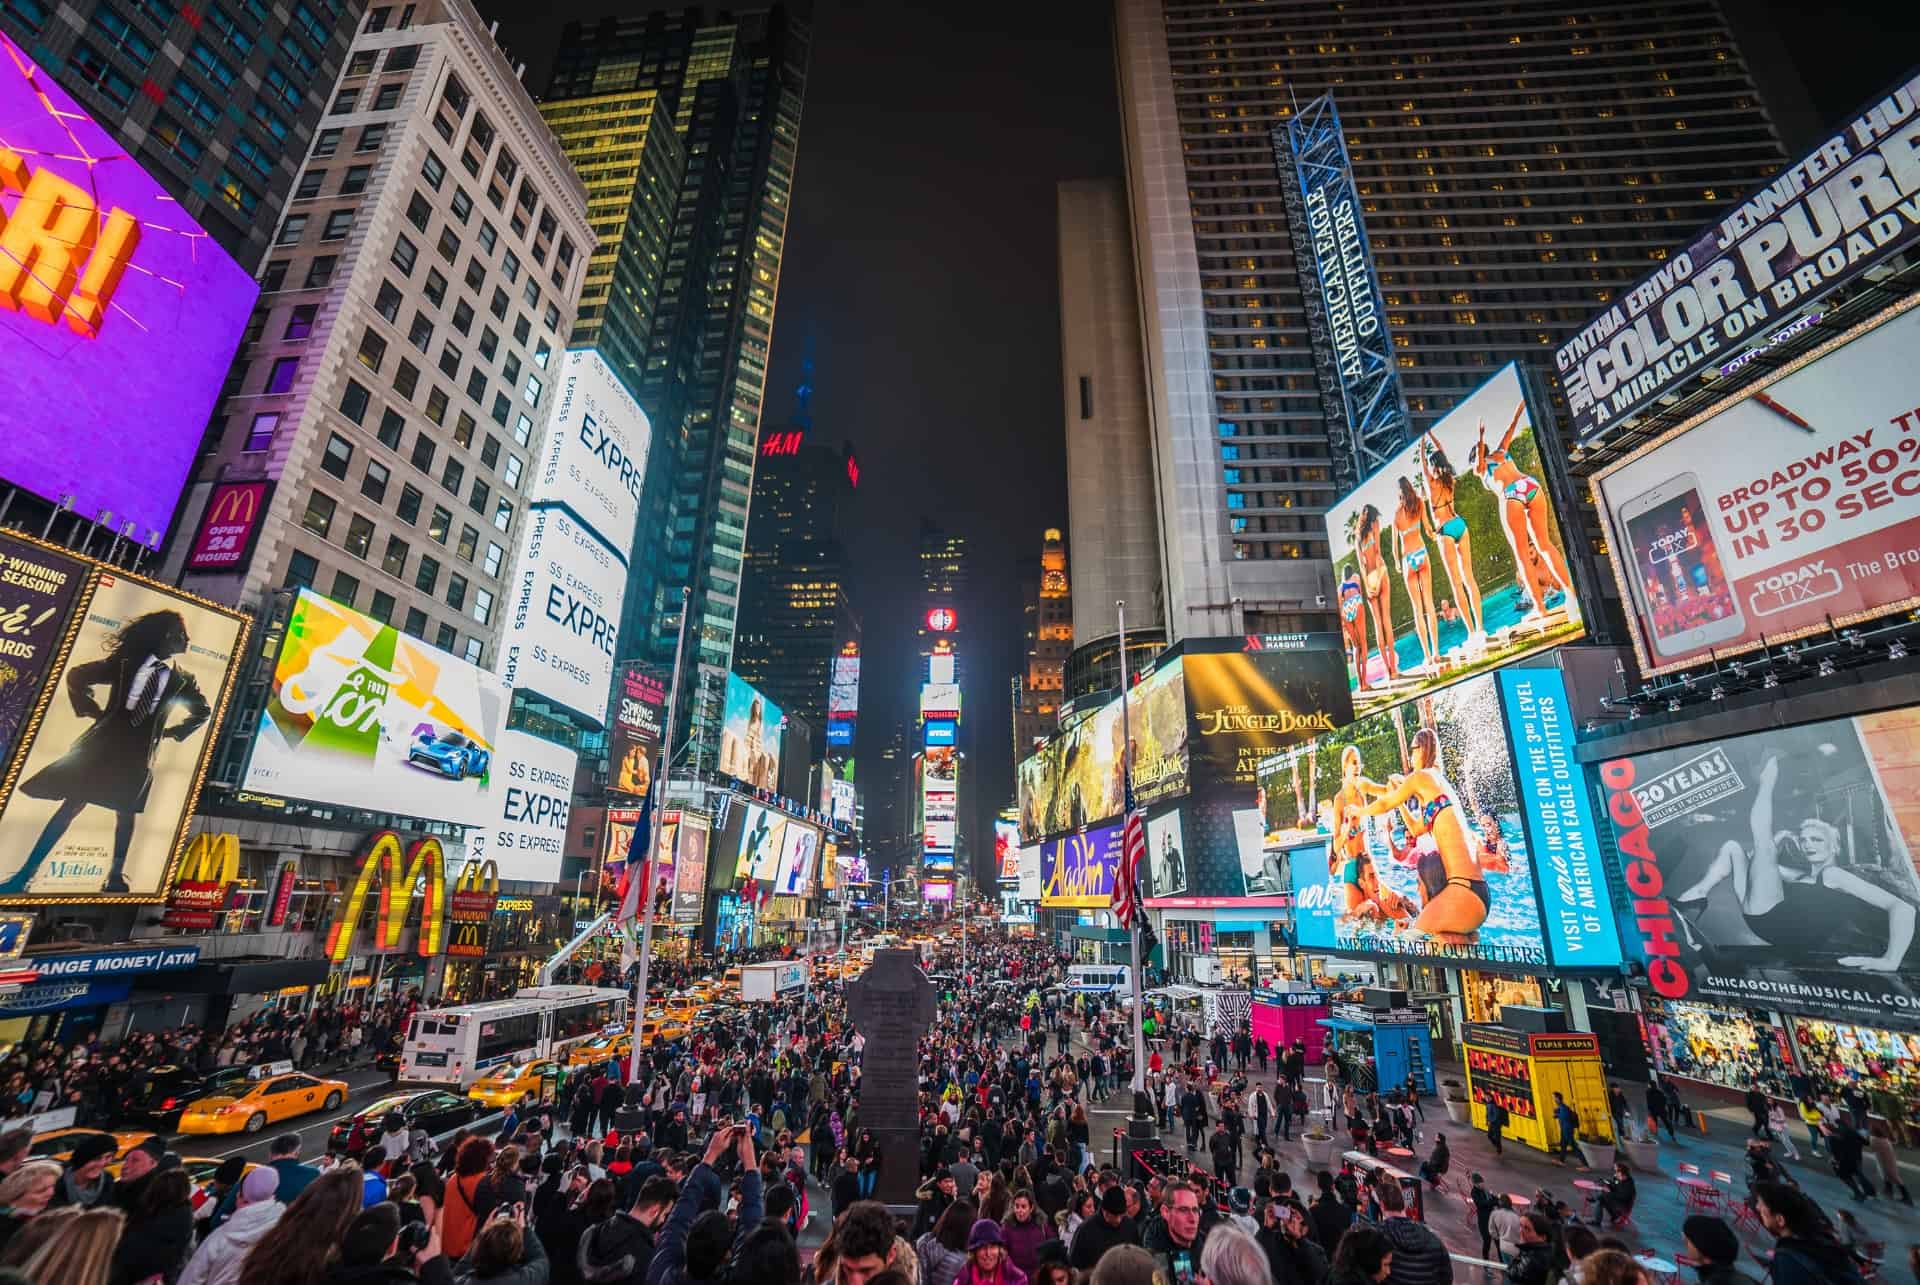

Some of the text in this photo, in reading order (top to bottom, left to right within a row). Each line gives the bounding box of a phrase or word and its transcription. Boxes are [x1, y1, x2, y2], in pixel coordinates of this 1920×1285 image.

[1332, 199, 1378, 337] OUTFITTERS
[1556, 305, 1627, 372] CYNTHIA
[1625, 252, 1694, 317] ERIVO
[1717, 135, 1852, 249] JENNIFER
[1307, 186, 1363, 382] AMERICAN EAGLE
[1584, 258, 1747, 399] COLOR
[1612, 328, 1720, 413] MIRACLE
[1722, 296, 1769, 338] ON
[559, 376, 577, 422] EXPRESS
[1563, 362, 1596, 418] THE
[545, 431, 564, 485] EXPRESS
[1717, 428, 1875, 512] BROADWAY
[1724, 501, 1770, 533] UP
[1776, 476, 1831, 510] TO
[207, 535, 238, 551] 24
[208, 525, 246, 535] OPEN
[557, 517, 609, 568] SS EXPRESS
[1650, 527, 1689, 550] TODAY
[1731, 528, 1770, 560] IN
[1776, 508, 1826, 542] 30
[193, 551, 241, 562] HOURS
[1754, 546, 1920, 594] TODAY The Bro
[1, 569, 59, 596] SEASON!
[515, 570, 535, 630] EXPRESS
[548, 561, 603, 608] SS EXPRESS
[1774, 580, 1817, 604] TIX
[532, 645, 592, 685] SS EXPRESS
[1266, 641, 1305, 649] MARQUIS
[923, 711, 959, 719] TOSHIBA
[1226, 705, 1250, 714] THE
[1516, 680, 1537, 719] LEVEL
[1201, 709, 1280, 735] JUNGLE
[1238, 747, 1251, 756] IN
[1530, 746, 1549, 774] THE
[509, 762, 570, 791] SS EXPRESS
[1536, 776, 1553, 797] ON
[1637, 754, 1727, 810] 20 YEARS
[503, 787, 569, 830] EXPRE
[1538, 696, 1601, 933] OF AMERICAN EAGLE OUTFITTERS
[1539, 801, 1563, 852] INSIDE
[497, 831, 560, 854] SS EXPRESS
[48, 861, 104, 878] Matilda
[1600, 757, 1689, 999] CHICAGO
[496, 899, 534, 911] EXPRESS
[1561, 905, 1584, 952] VISIT
[94, 955, 158, 972] MONEY
[162, 952, 196, 967] ATM
[1336, 935, 1546, 965] AMERICAN EAGLE OUTFITTERS
[1298, 994, 1321, 1005] NYC
